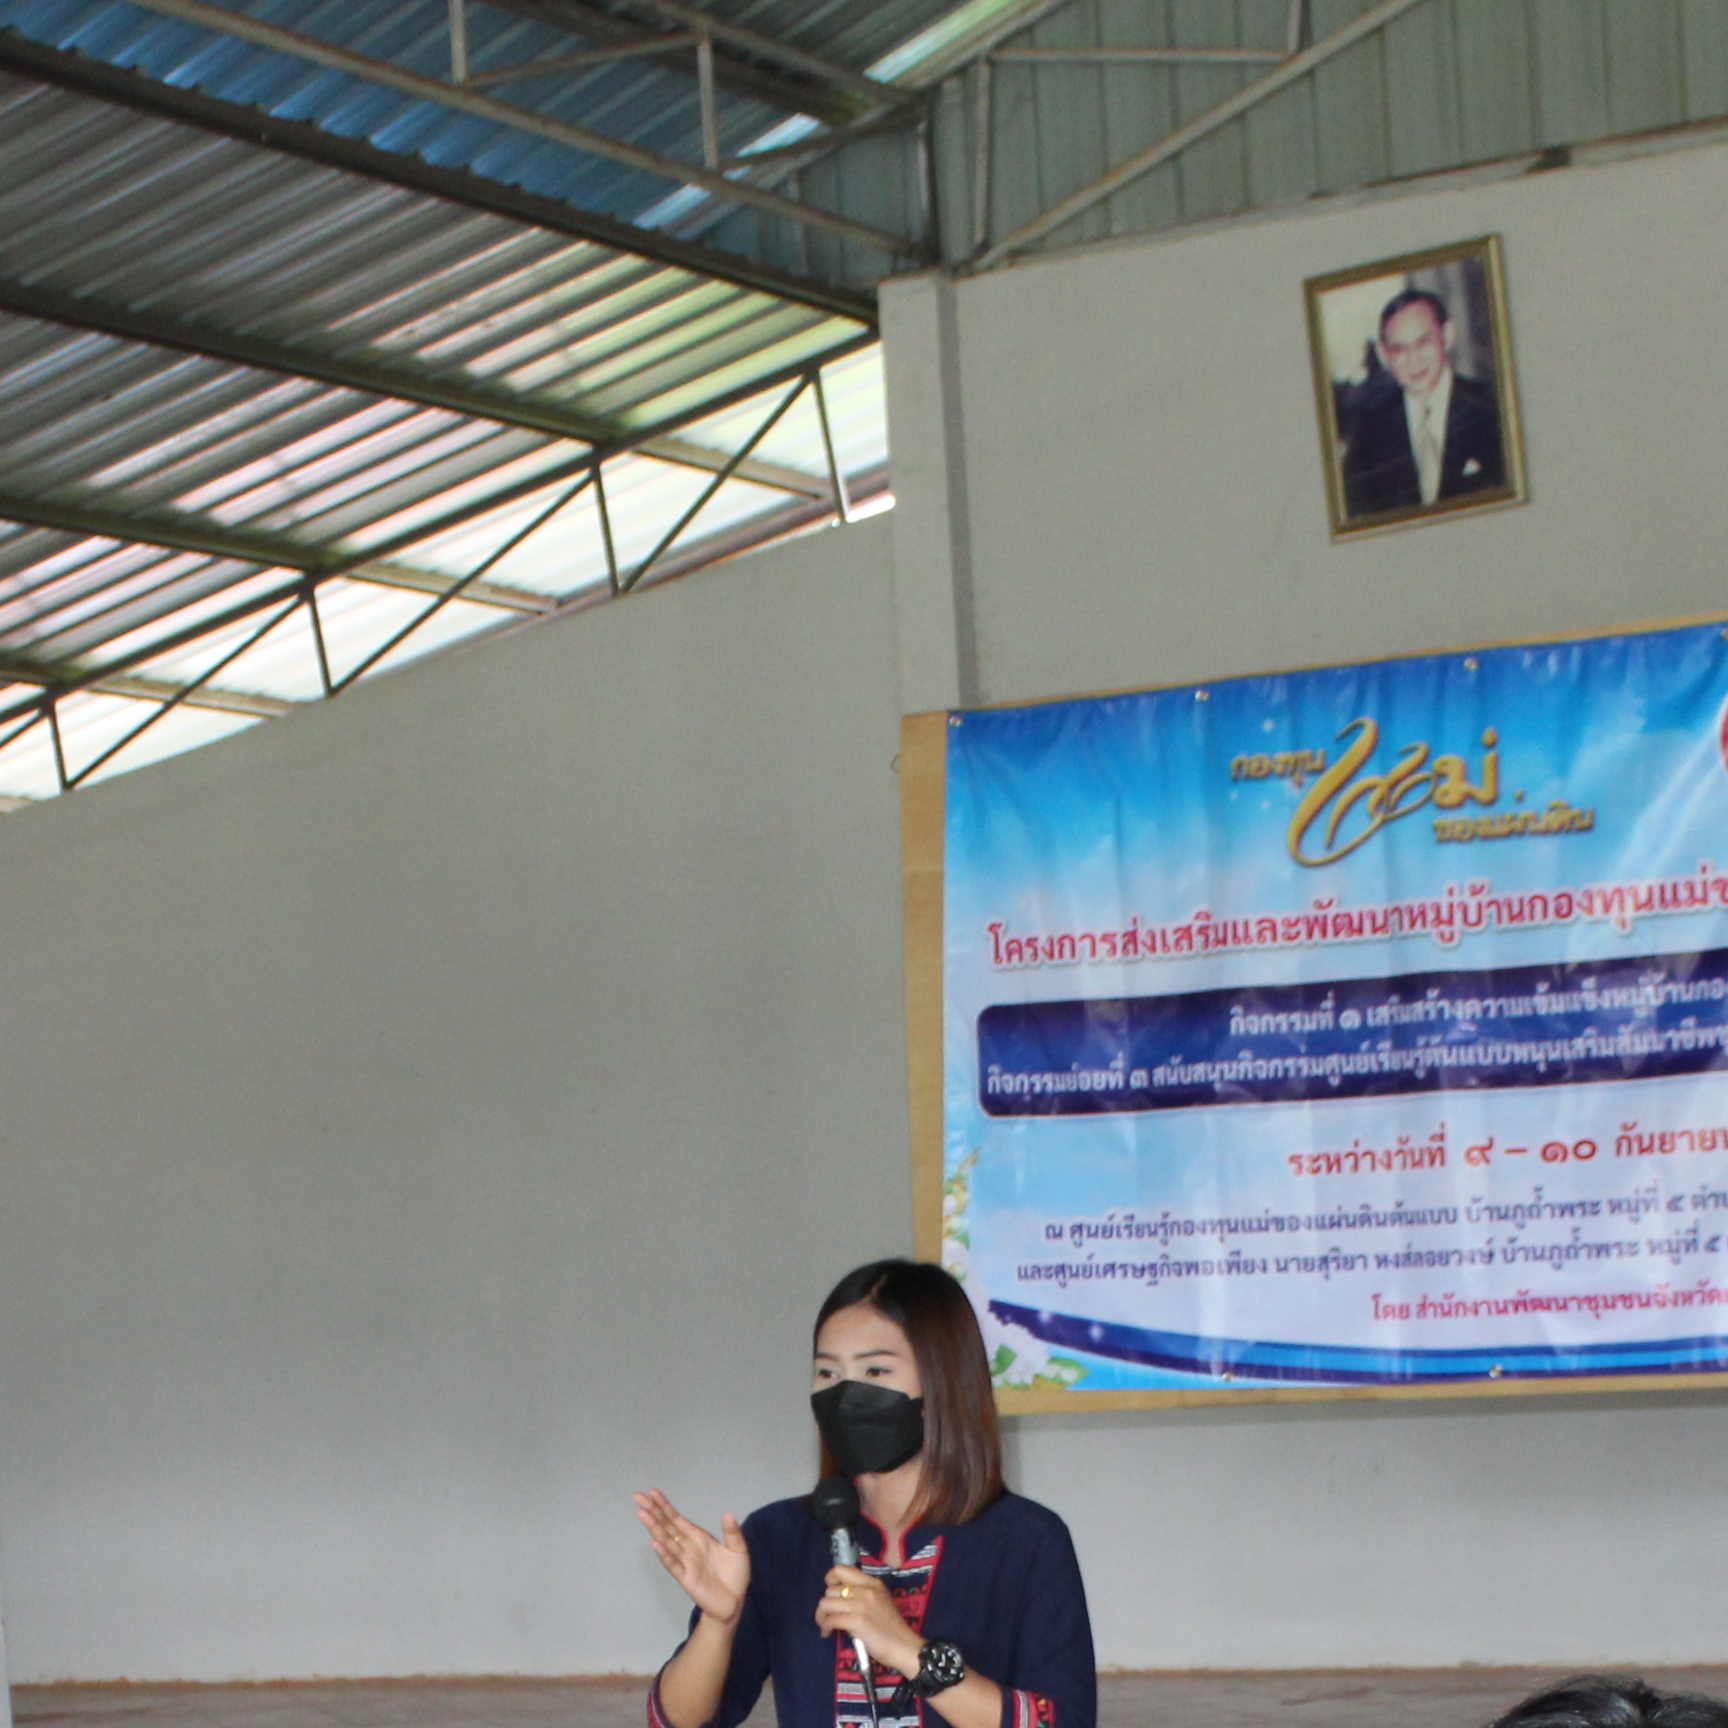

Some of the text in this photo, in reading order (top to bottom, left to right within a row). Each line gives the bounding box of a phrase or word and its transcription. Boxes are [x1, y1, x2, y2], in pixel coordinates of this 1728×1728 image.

[1288, 1122, 1446, 1177] ระหว่างวันที่
[1044, 1221, 1063, 1241] ณ
[1372, 1294, 1410, 1322] โดย
